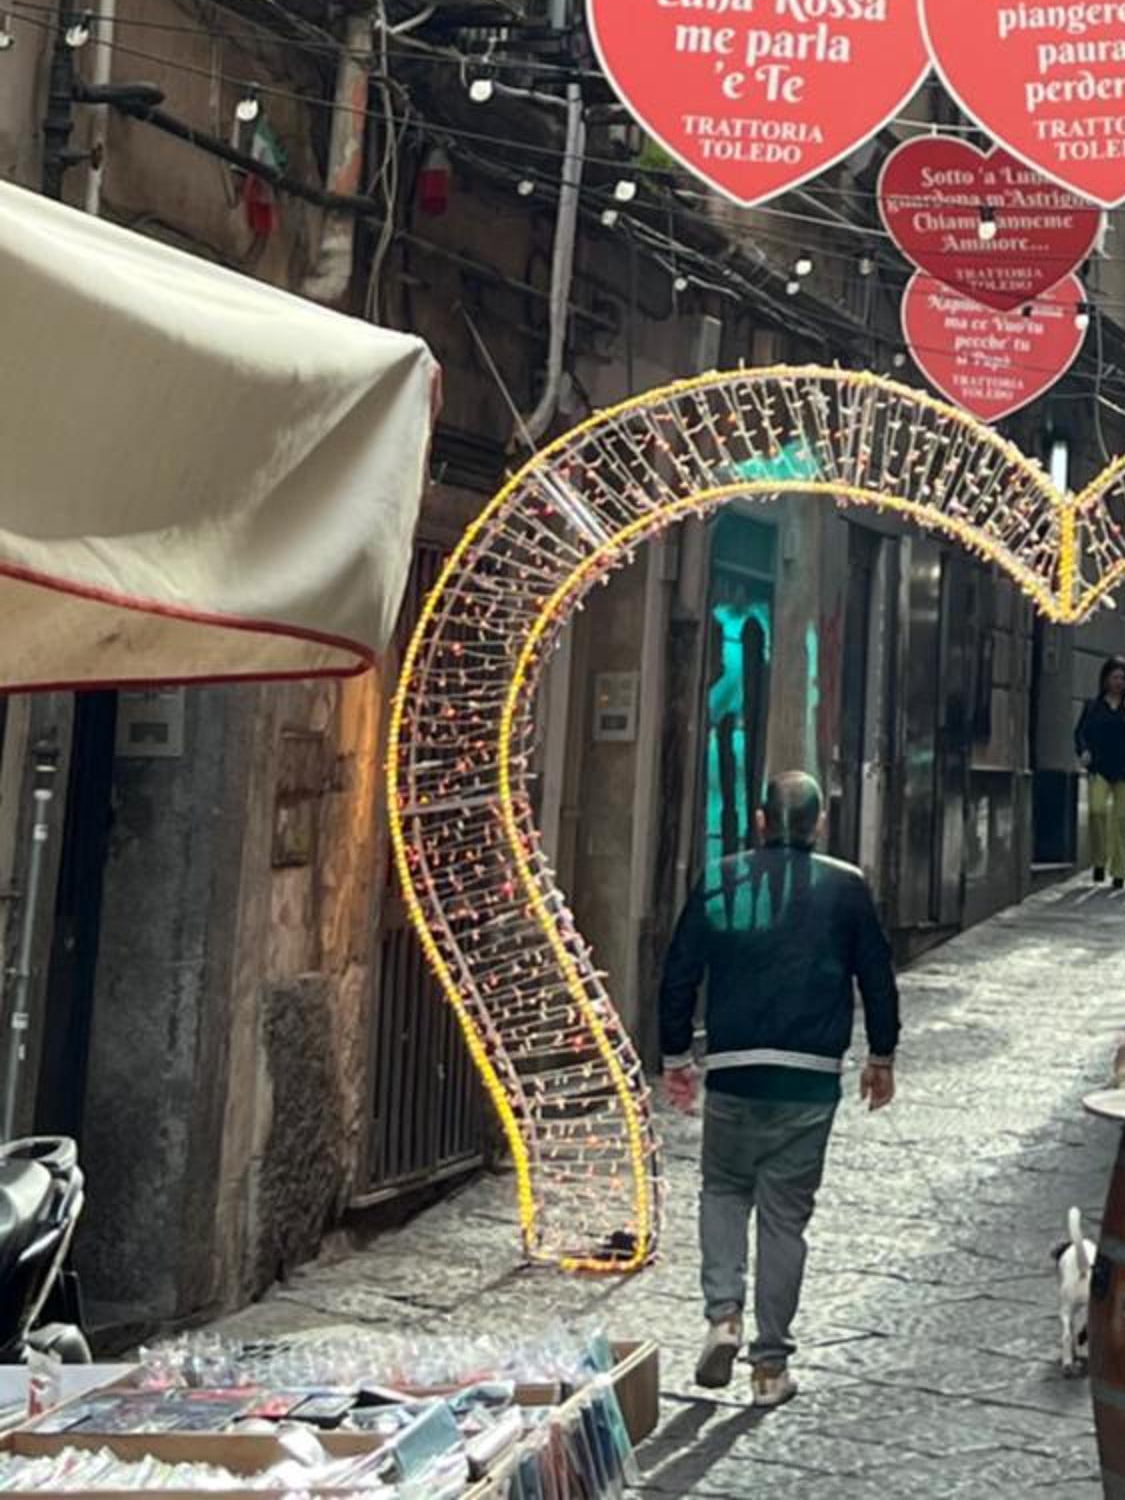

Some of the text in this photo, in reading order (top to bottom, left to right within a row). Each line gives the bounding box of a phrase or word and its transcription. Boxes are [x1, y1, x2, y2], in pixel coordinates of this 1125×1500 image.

[675, 23, 850, 67] me parla
[755, 64, 804, 103] Te
[682, 115, 823, 143] TRATTORIA
[700, 139, 802, 164] TOLEDO
[921, 166, 974, 188] Sotto
